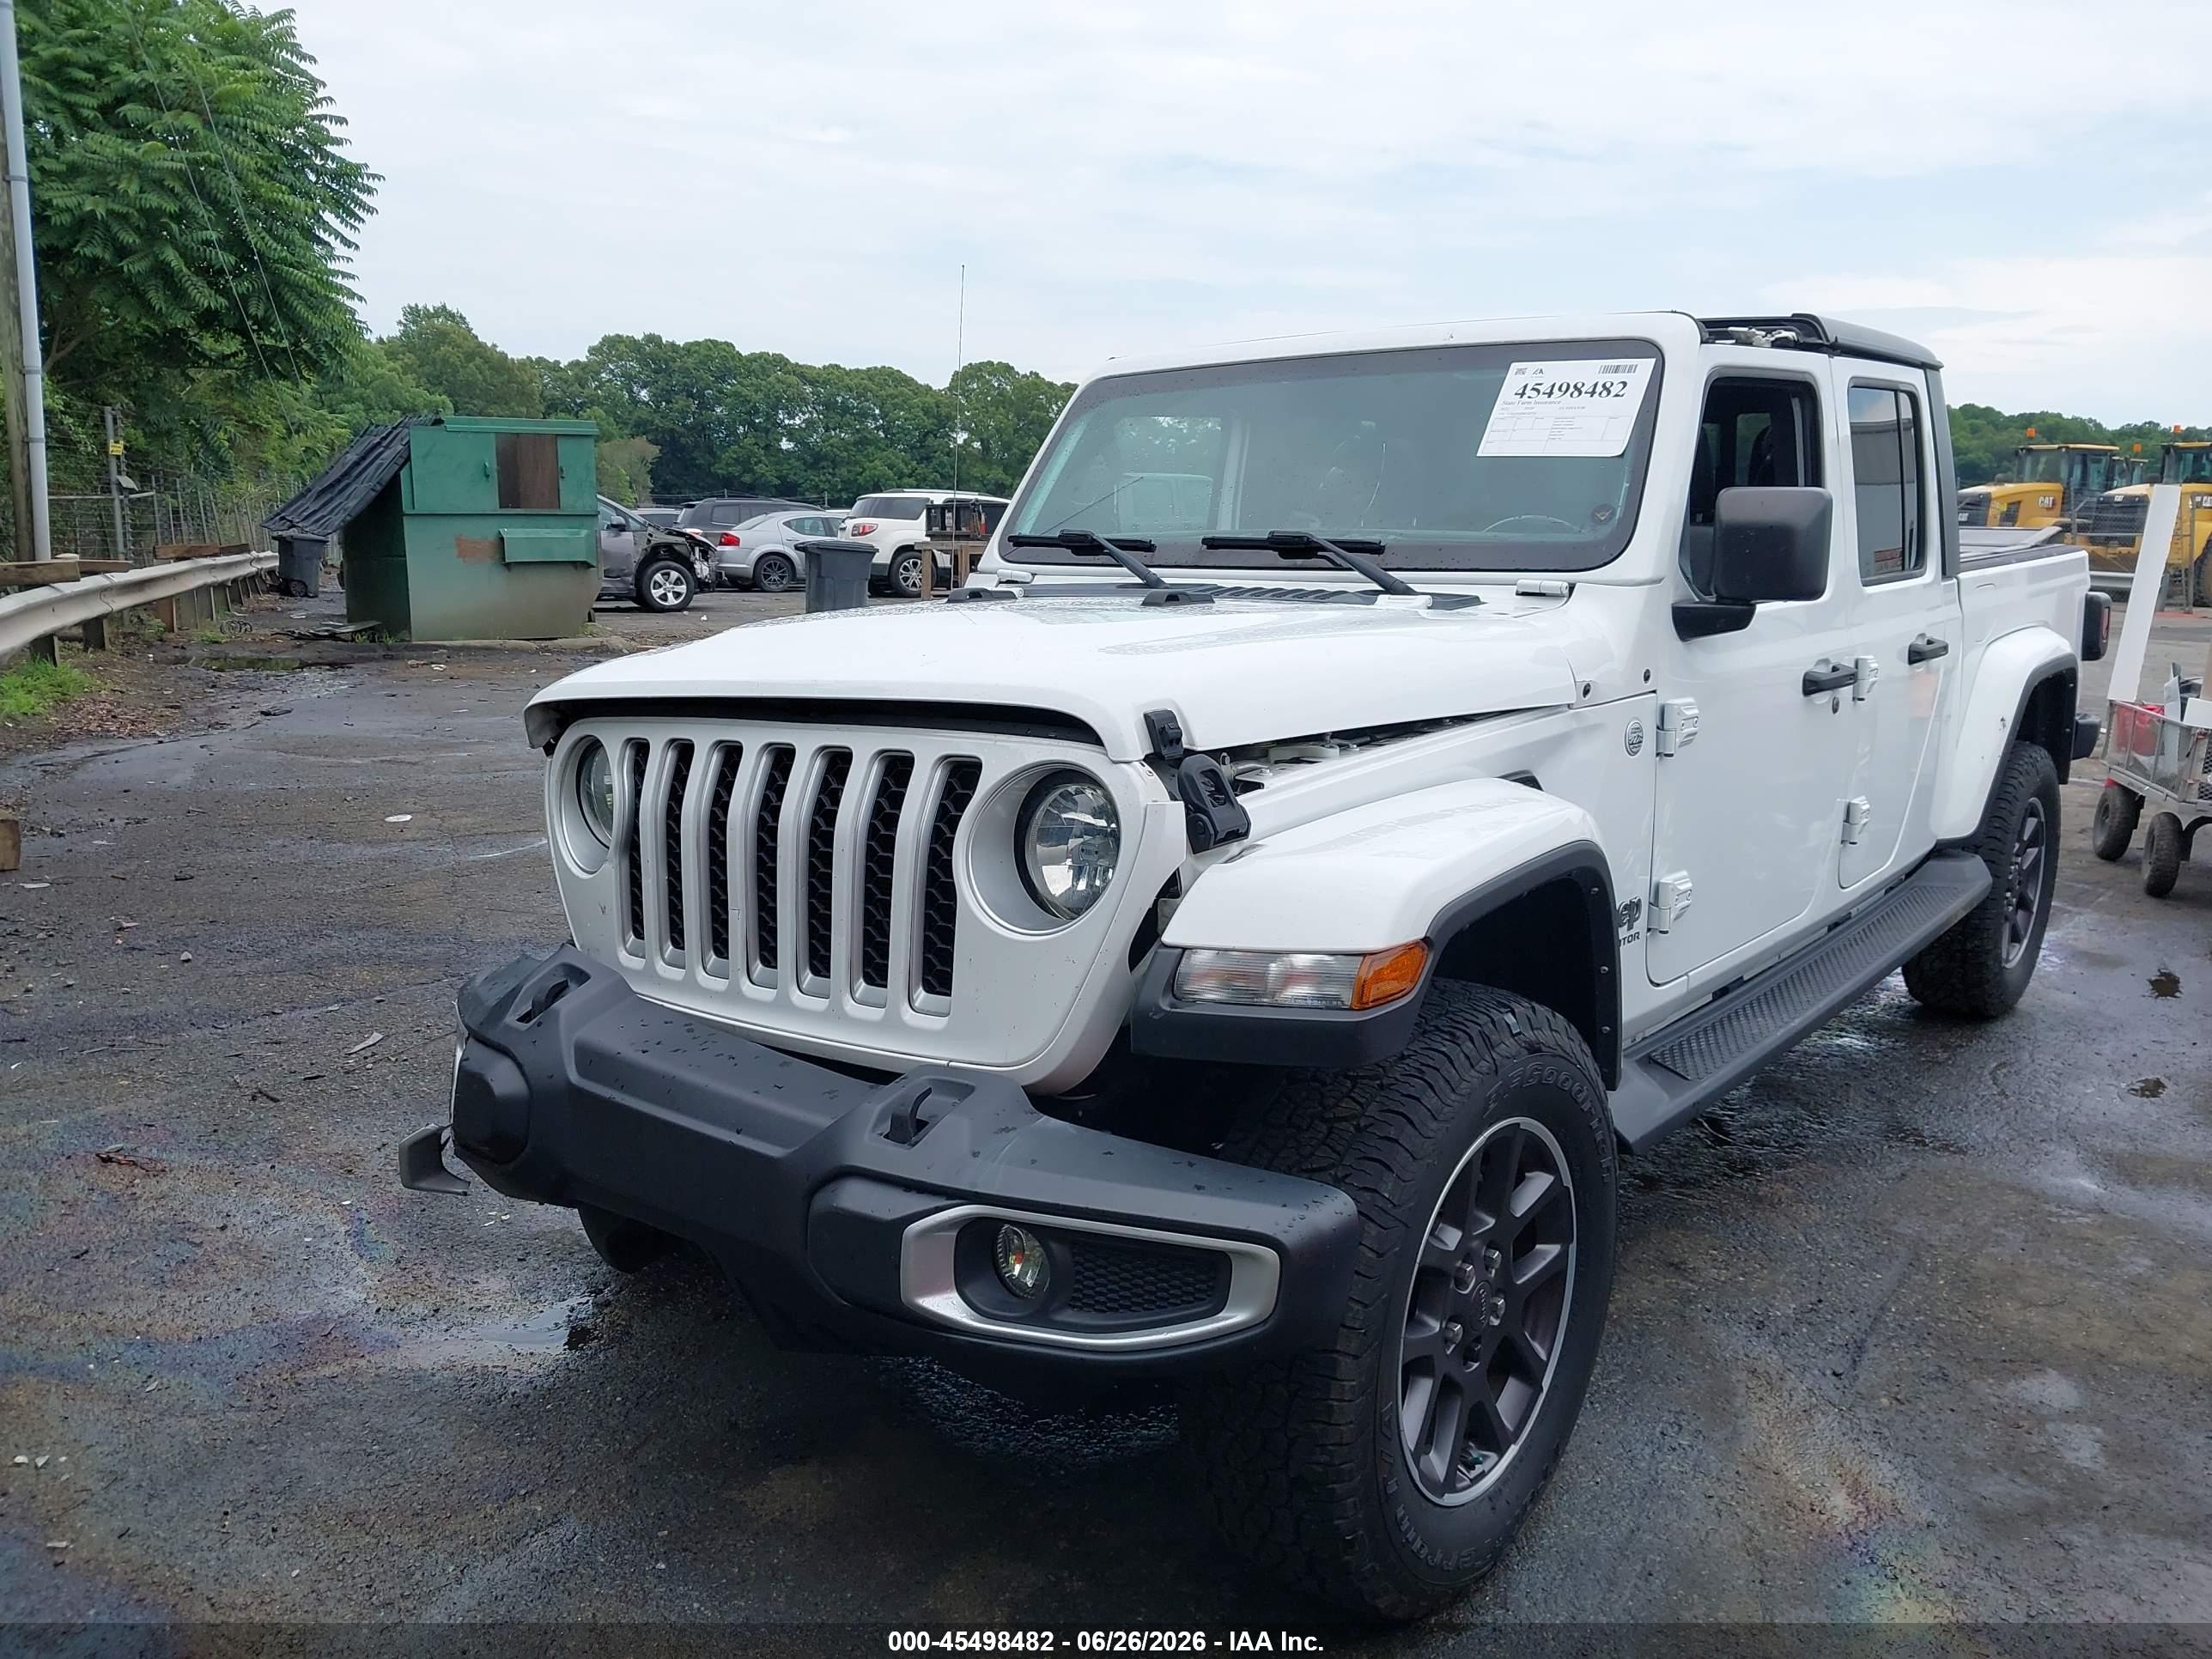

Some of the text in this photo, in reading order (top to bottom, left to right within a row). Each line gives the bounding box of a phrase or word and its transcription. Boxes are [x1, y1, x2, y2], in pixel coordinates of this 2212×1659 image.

[1514, 380, 1628, 398] 45498482
[2039, 495, 2054, 507] CAT
[1619, 896, 1642, 931] ep
